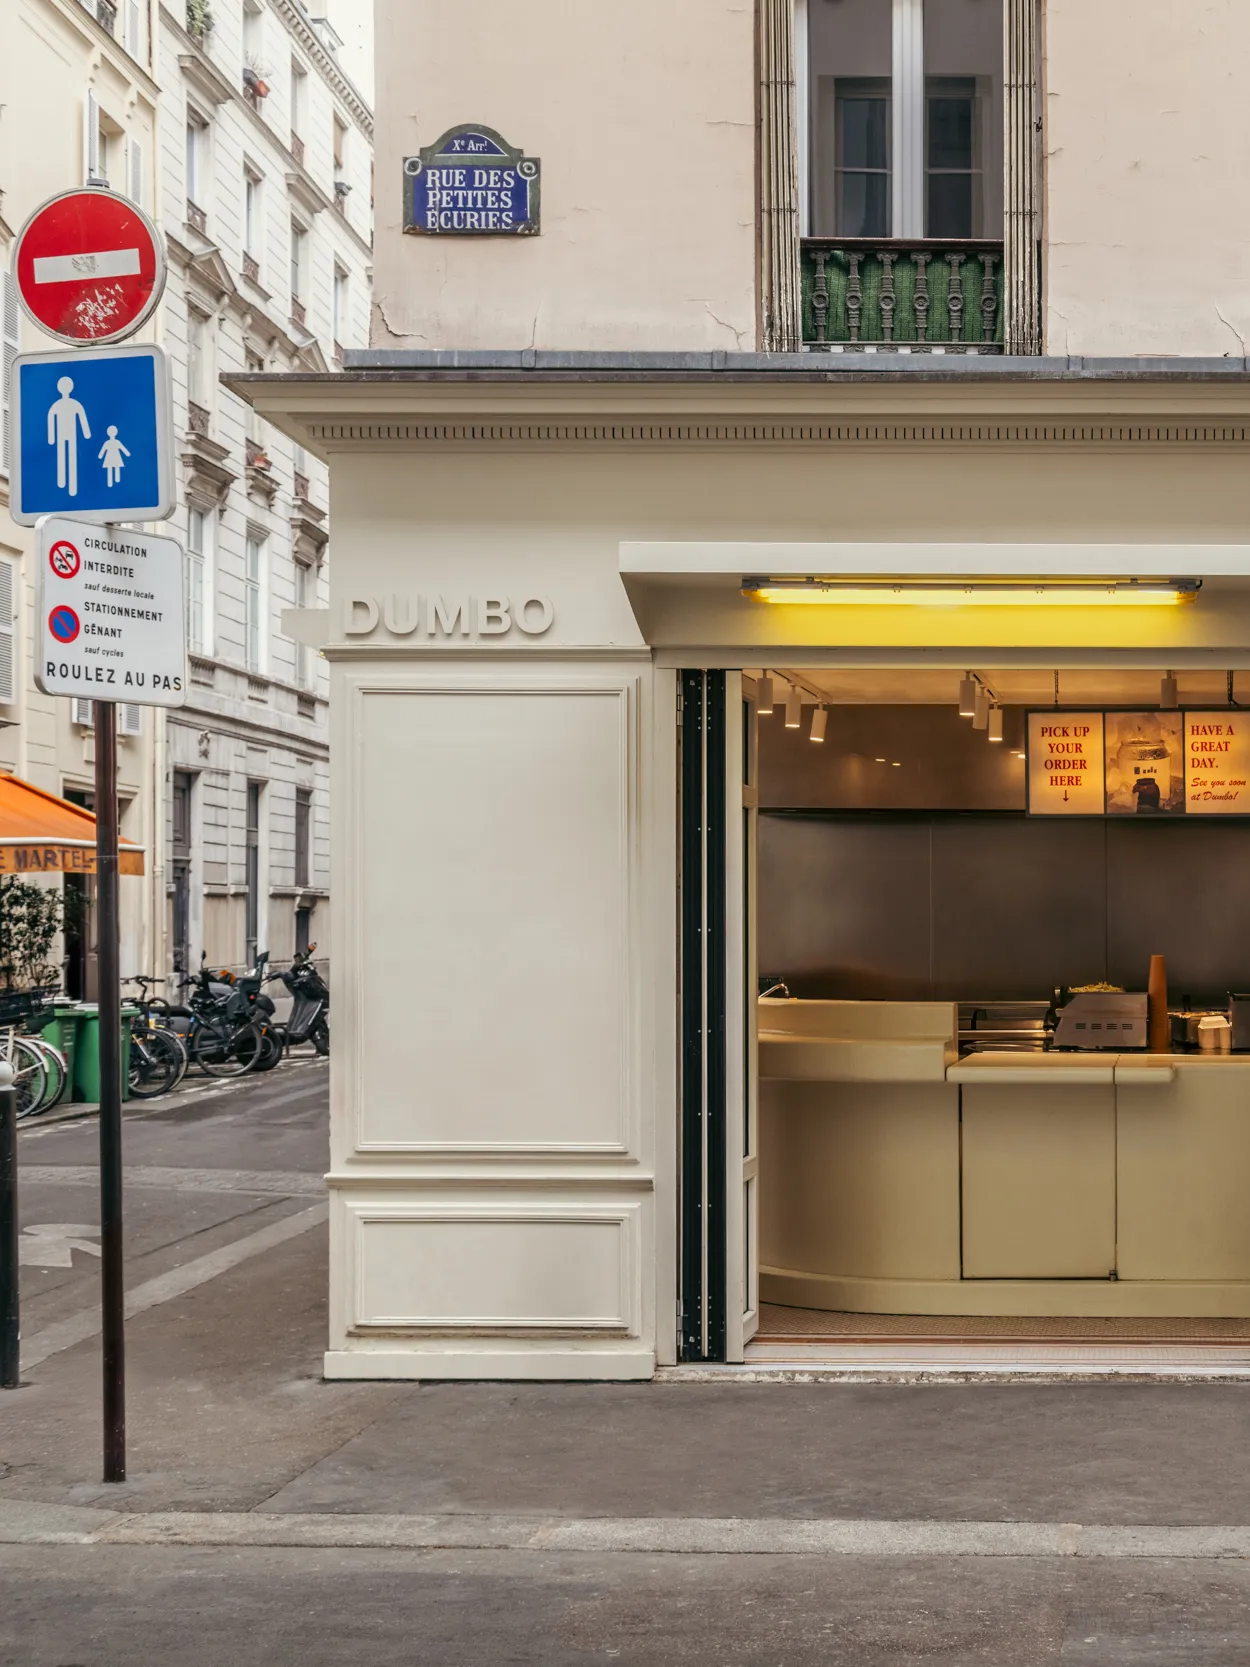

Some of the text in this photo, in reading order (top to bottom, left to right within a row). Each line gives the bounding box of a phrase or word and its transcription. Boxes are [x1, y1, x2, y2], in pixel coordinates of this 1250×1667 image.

[426, 169, 515, 188] RUE DES
[427, 190, 512, 208] PETITES
[84, 537, 147, 558] CIRCULATION
[84, 560, 134, 578] INTERDITE
[84, 582, 154, 600] sauf desserte locale
[84, 601, 163, 622] STATIONNEMENT
[344, 595, 555, 636] DUMBO
[84, 624, 122, 638] GÊNANT
[84, 646, 124, 658] sauf cycles
[46, 661, 182, 691] ROULEZ AU PAS
[1041, 727, 1090, 737] PICK UP
[1191, 725, 1234, 735] HAVE A
[1048, 743, 1083, 753] YOUR
[1191, 741, 1230, 752] GREAT
[1044, 759, 1087, 770] ORDER
[1191, 757, 1218, 768] DAY.
[1049, 776, 1082, 786] HERE
[1191, 777, 1207, 787] See
[1211, 780, 1225, 788] you
[1191, 791, 1239, 801] at Dumbo!
[14, 849, 92, 869] MARTEL
